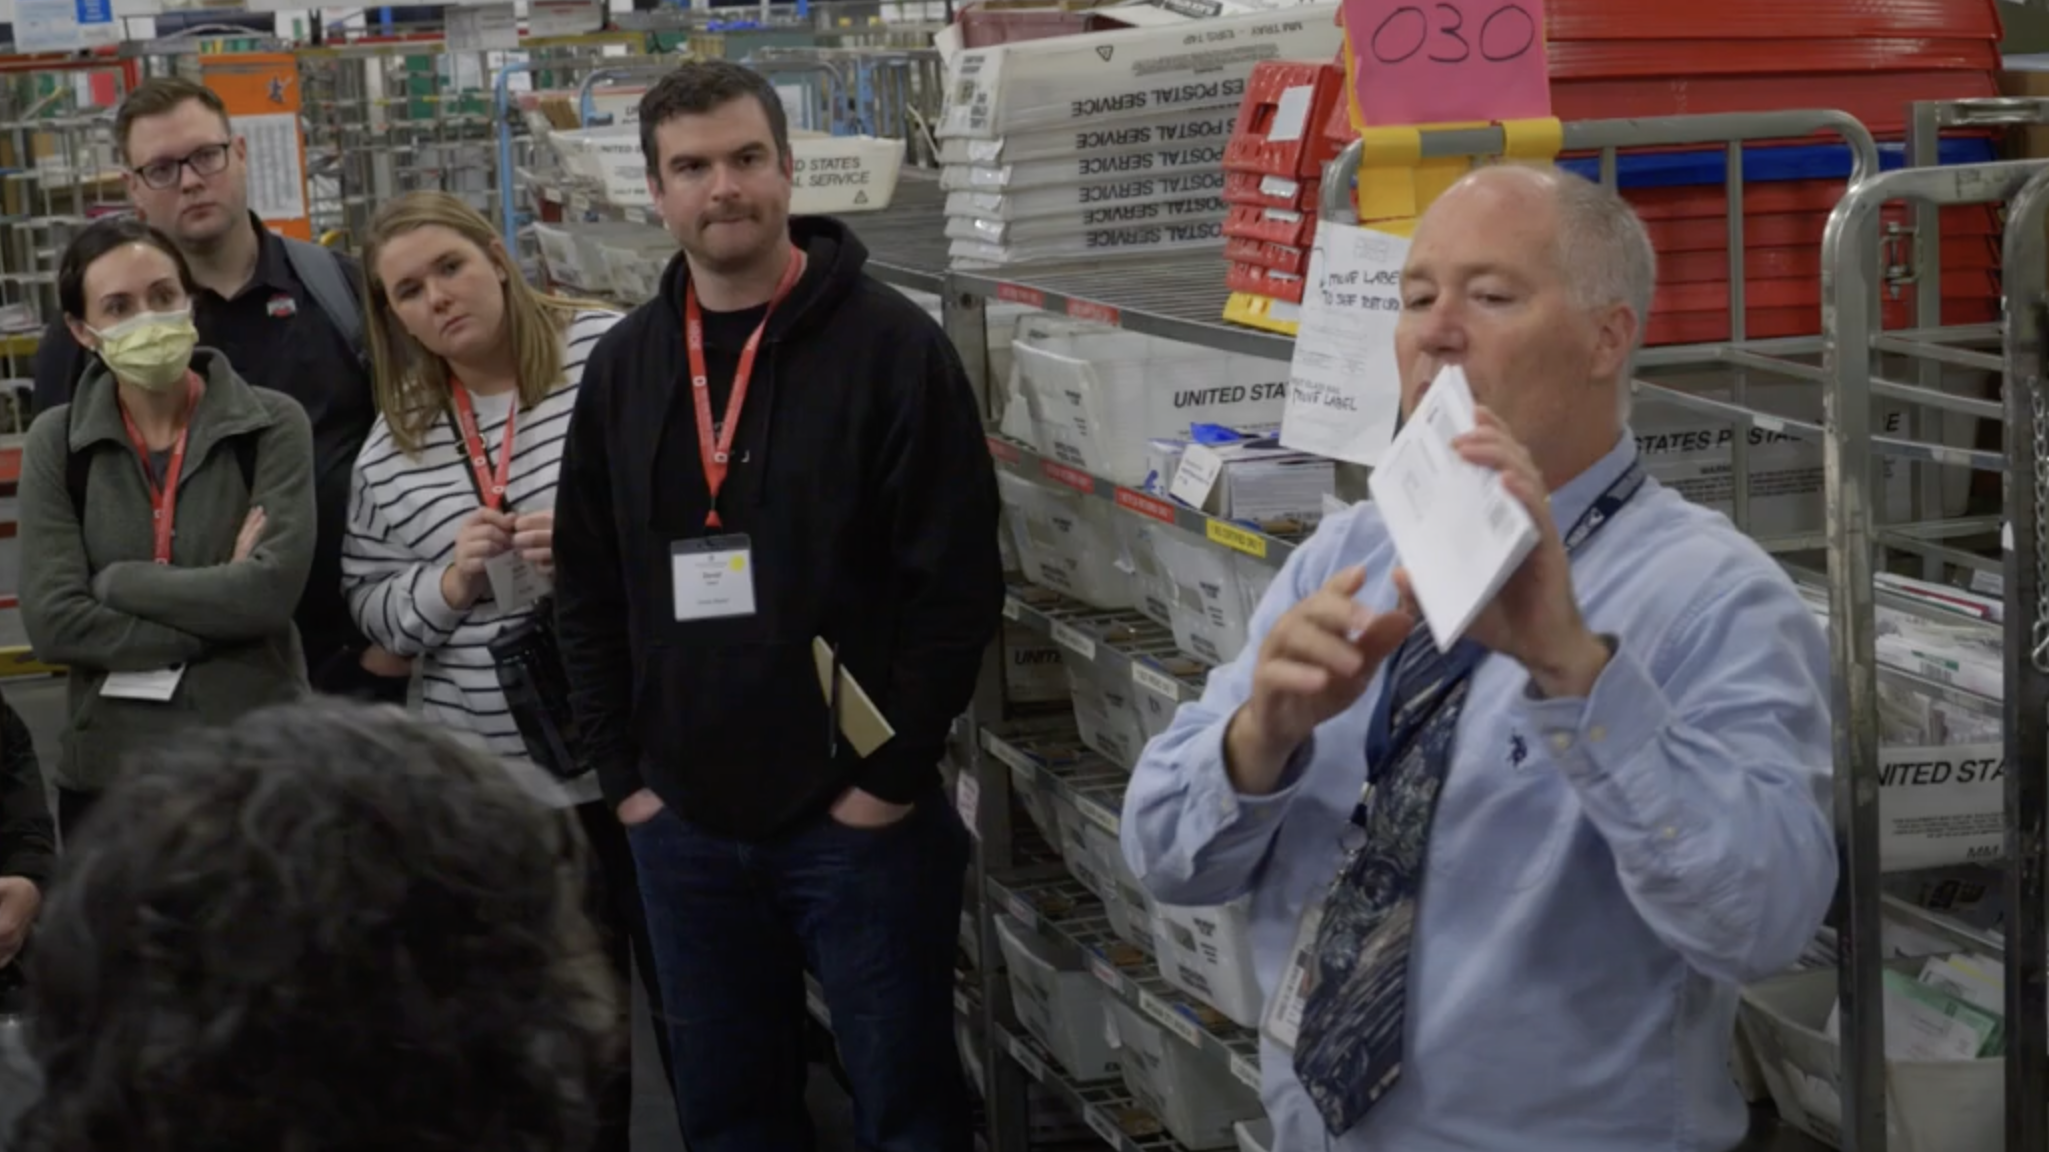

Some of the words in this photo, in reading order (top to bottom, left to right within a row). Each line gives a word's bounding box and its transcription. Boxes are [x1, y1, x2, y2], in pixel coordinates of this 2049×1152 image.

[1371, 3, 1535, 64] 030
[1071, 91, 1146, 117] SERVICE
[1151, 82, 1218, 105] POSTAL
[1076, 127, 1152, 150] SERVICE
[1155, 119, 1222, 141] POSTAL
[809, 156, 861, 172] STATES
[1079, 153, 1154, 175] SERVICE
[1158, 147, 1226, 167] POSTAL
[809, 171, 871, 187] SERVICE
[1159, 174, 1225, 193] POSTAL
[1079, 180, 1154, 203] SERVICE
[1083, 202, 1160, 225] SERVICE
[1087, 228, 1161, 247] SERVICE
[1174, 385, 1246, 409] UNITED
[1250, 381, 1289, 401] STA
